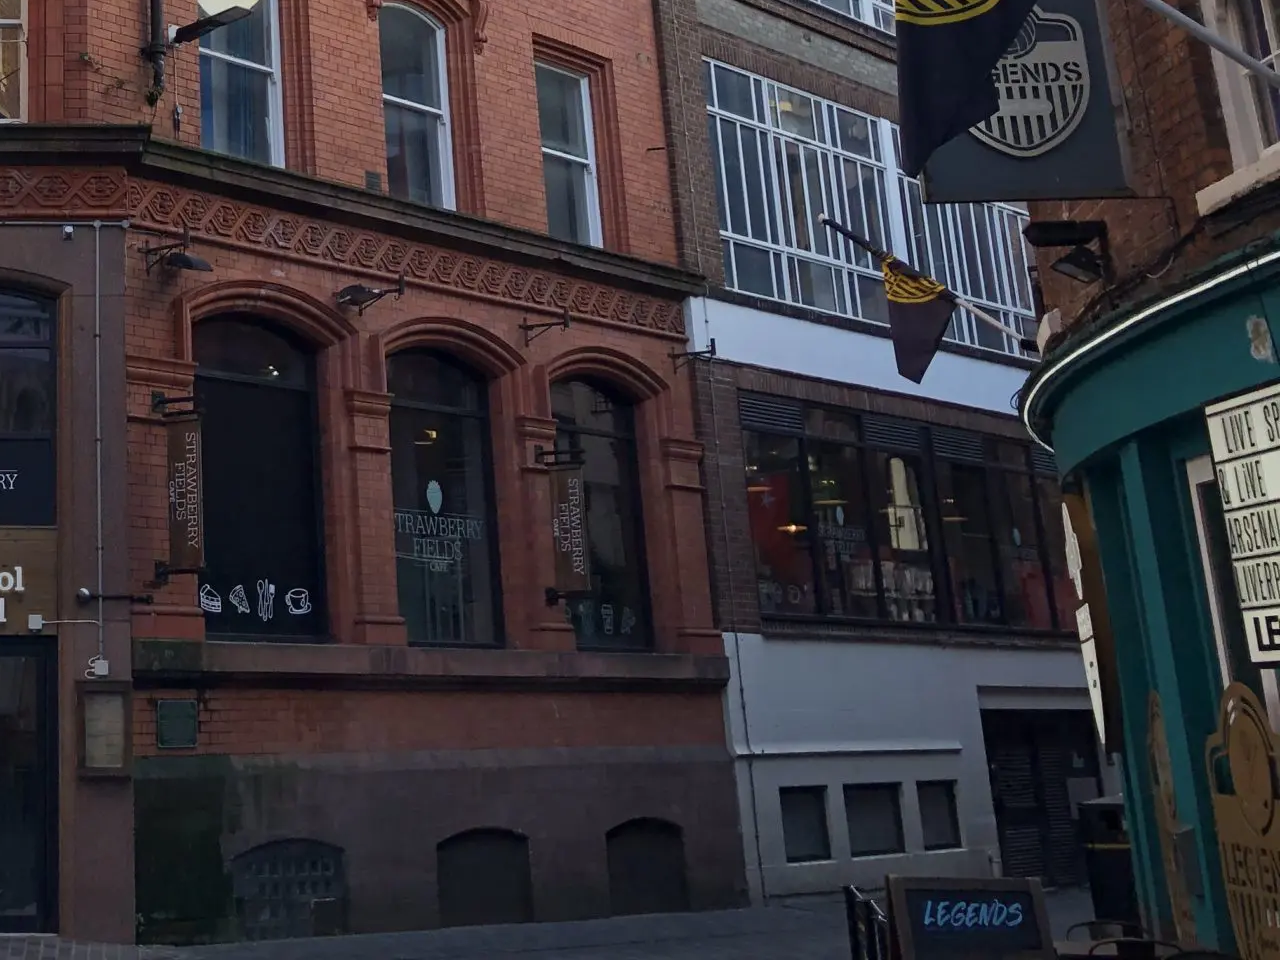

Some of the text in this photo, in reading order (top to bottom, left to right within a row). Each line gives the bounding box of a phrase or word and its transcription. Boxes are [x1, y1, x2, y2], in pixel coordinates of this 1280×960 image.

[1222, 401, 1280, 454] LIVE SP
[175, 462, 186, 521] FIELDS
[186, 432, 198, 548] STRAWBERRY
[1218, 468, 1231, 505] &
[395, 512, 484, 540] TRAWBERRY
[559, 503, 571, 552] FIELDS
[568, 478, 584, 575] STRAWBERRY
[413, 538, 463, 560] FIELDS
[1232, 561, 1280, 604] LIVERP
[1253, 615, 1280, 652] LE
[923, 898, 1023, 928] LEGENDS
